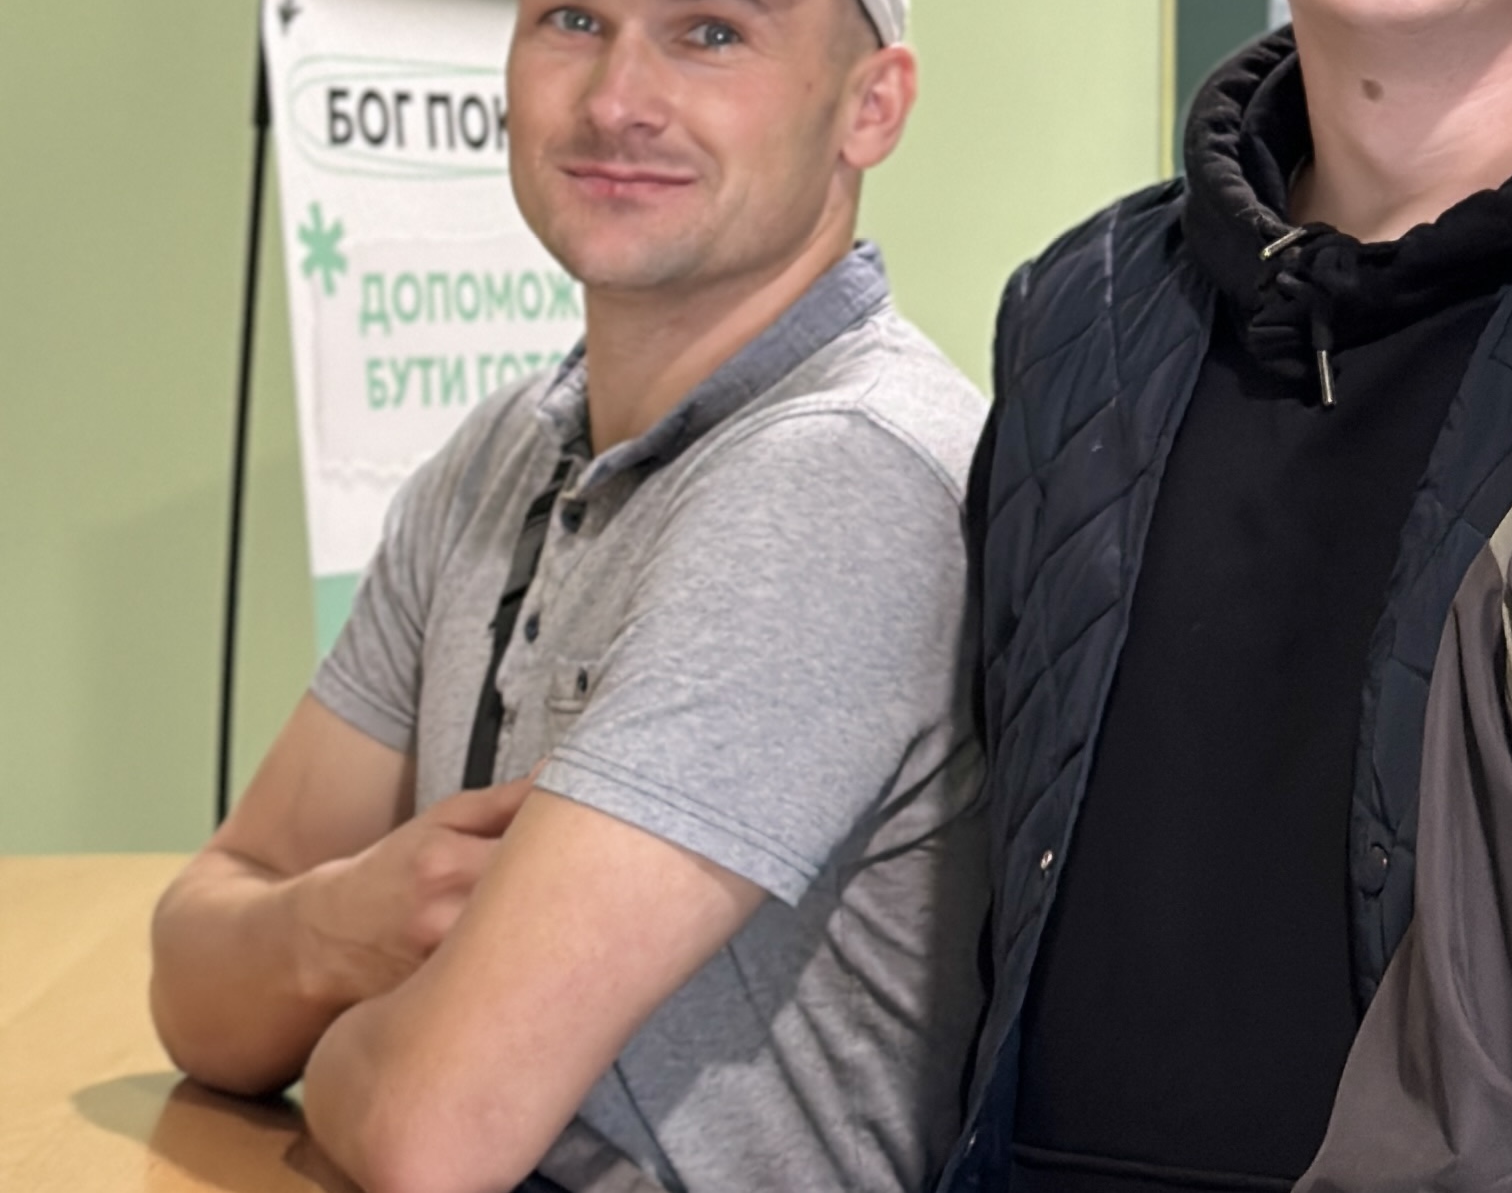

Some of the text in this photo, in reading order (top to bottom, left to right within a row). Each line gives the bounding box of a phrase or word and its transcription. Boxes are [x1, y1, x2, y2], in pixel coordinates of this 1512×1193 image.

[326, 87, 411, 148] БОГ
[358, 270, 582, 337] ДОПОМОЖ
[364, 351, 567, 410] БУТИ ГО
